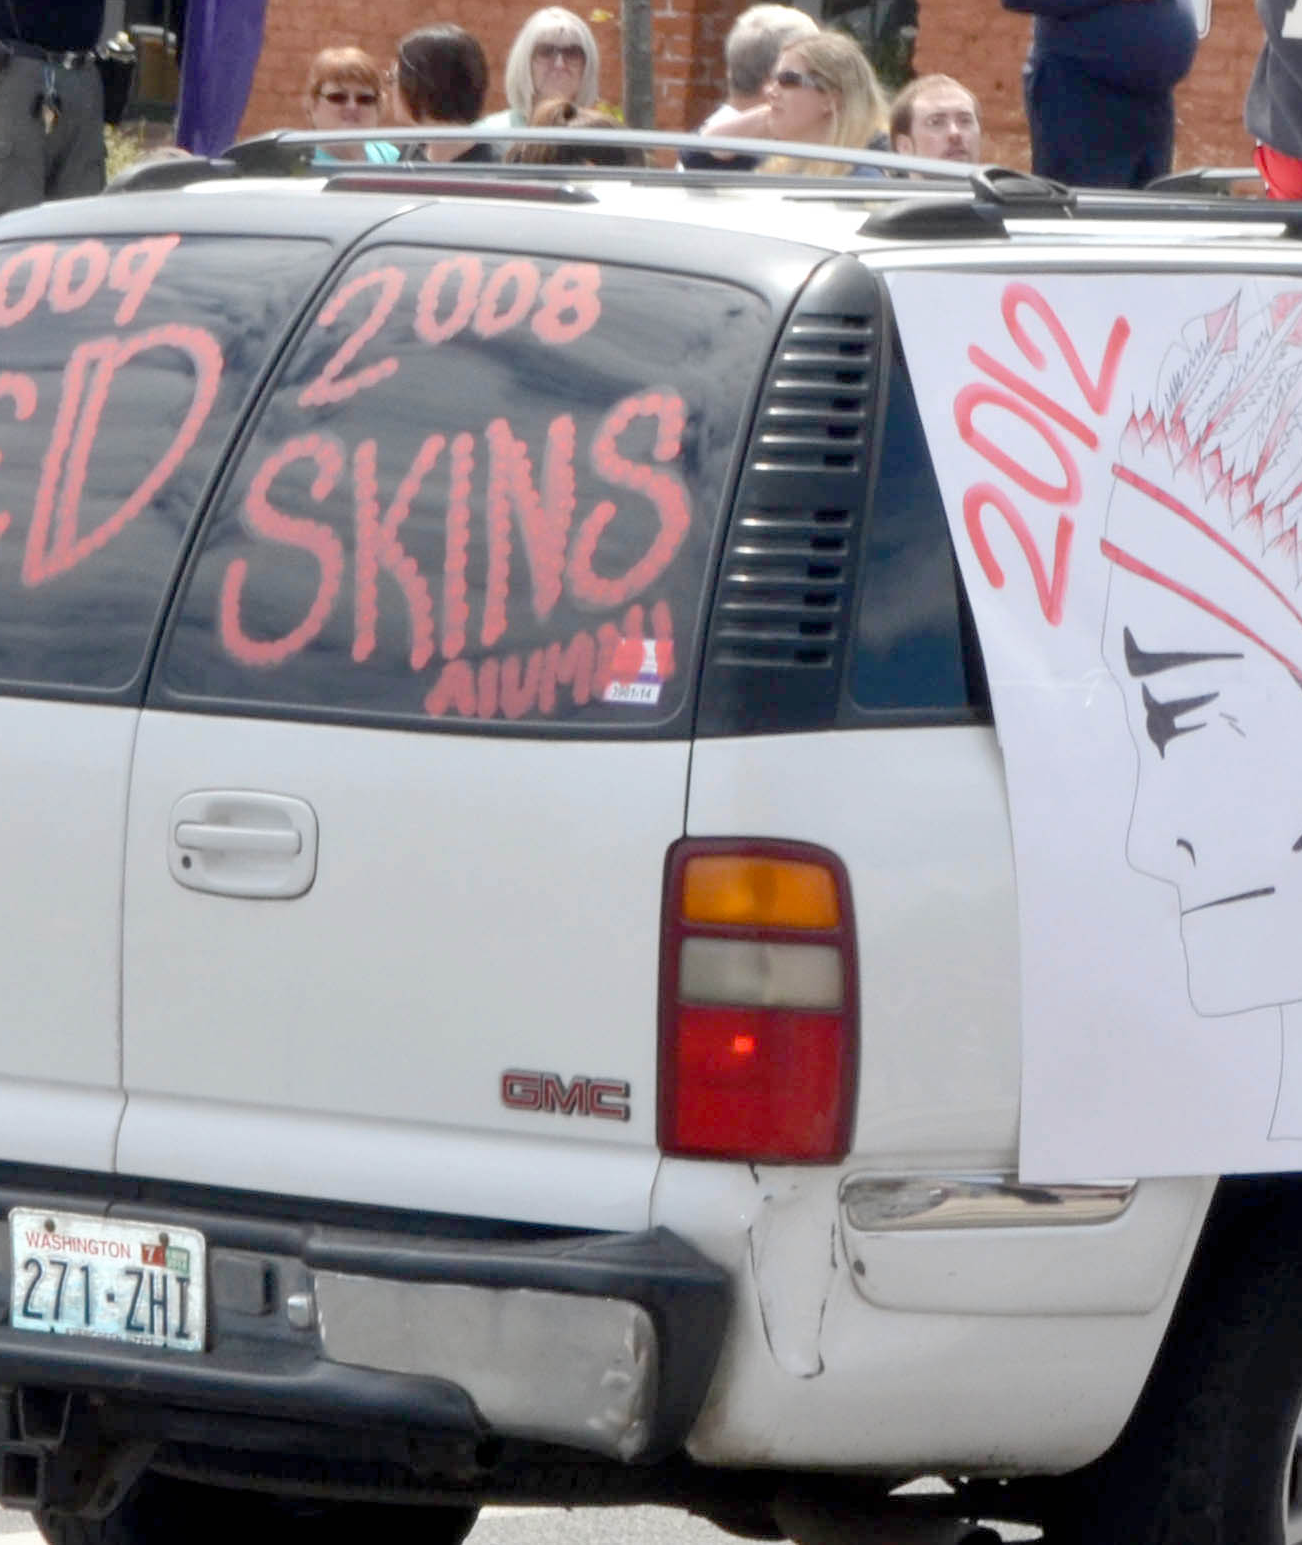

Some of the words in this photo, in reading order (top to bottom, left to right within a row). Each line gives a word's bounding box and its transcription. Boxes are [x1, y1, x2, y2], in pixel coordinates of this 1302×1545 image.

[298, 255, 602, 407] 2008
[218, 388, 691, 670] SKINS
[953, 281, 1131, 627] 2012
[501, 1069, 631, 1122] GMC
[25, 1231, 132, 1259] WASHINGTON
